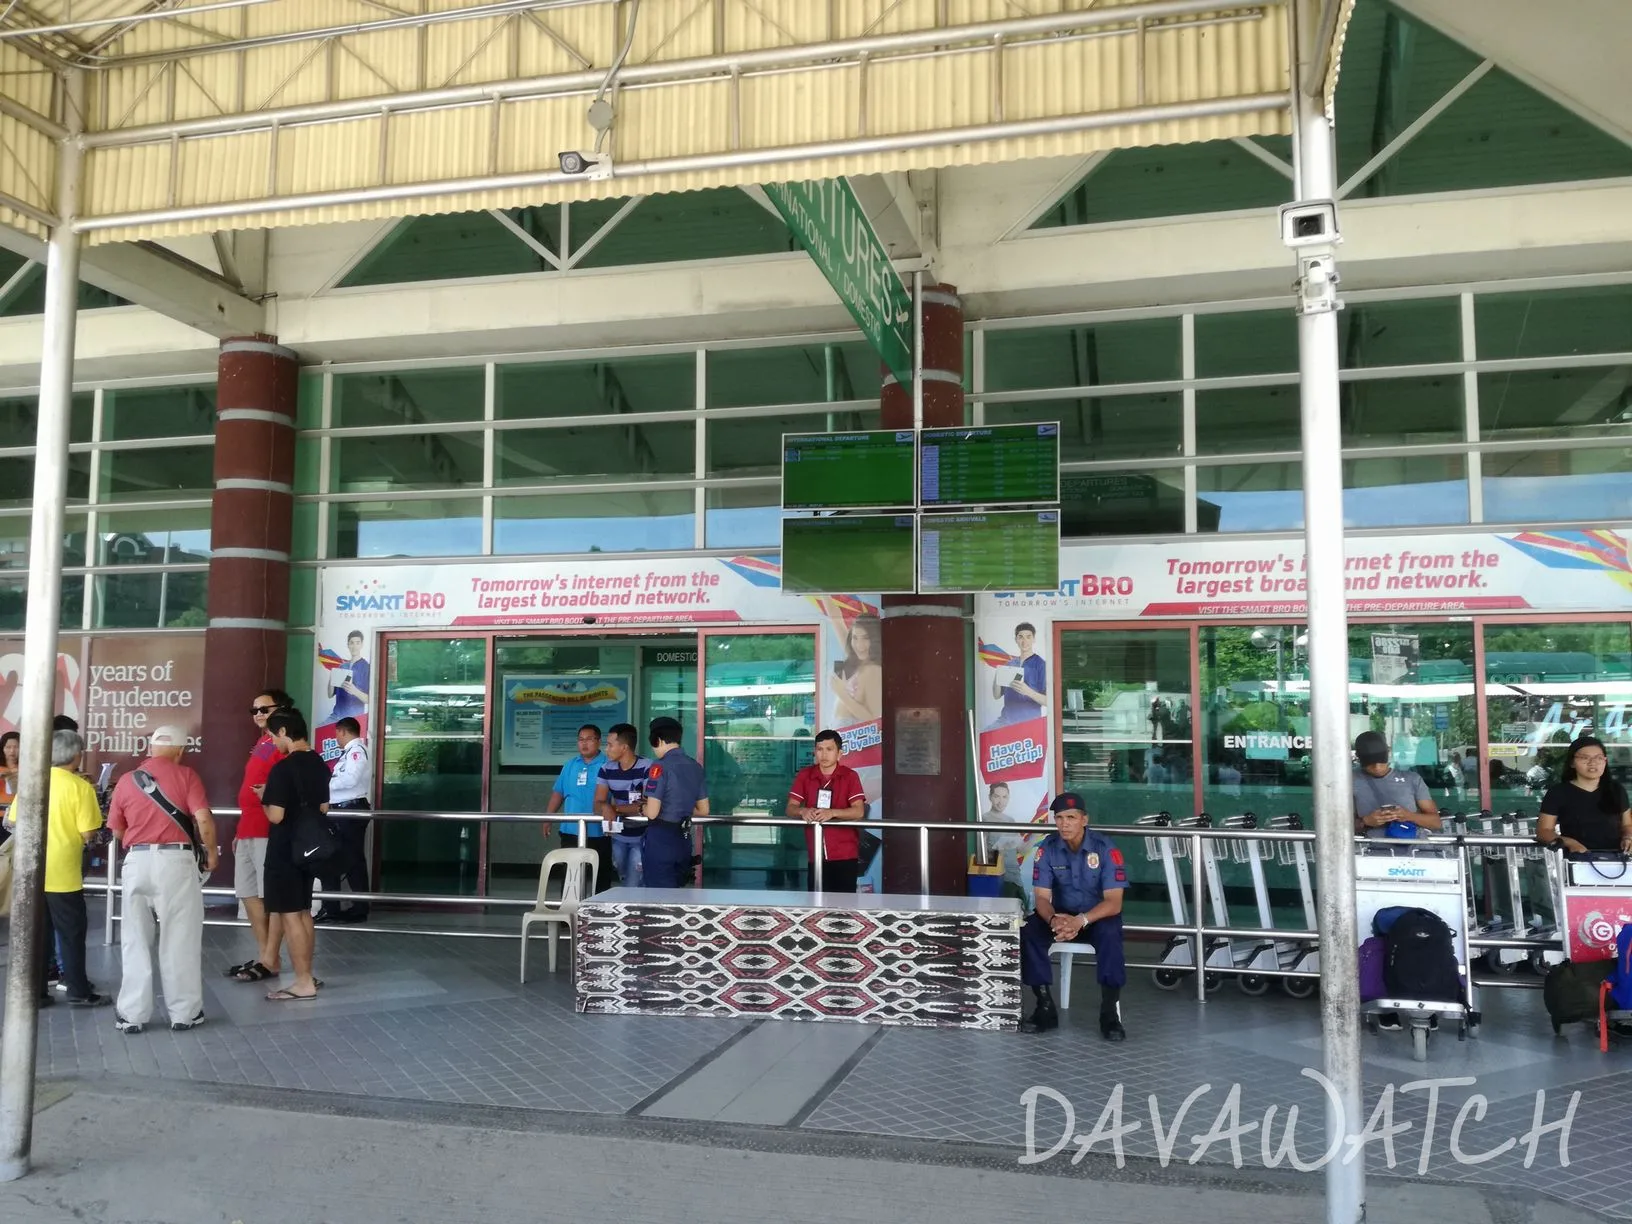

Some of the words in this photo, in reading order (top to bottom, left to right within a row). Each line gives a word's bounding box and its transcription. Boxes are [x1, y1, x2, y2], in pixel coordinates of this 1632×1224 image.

[802, 178, 892, 326] TURES
[843, 271, 881, 343] DOMESTIC
[1167, 554, 1295, 576] Tomorrow's
[1300, 553, 1392, 572] irnet
[1399, 551, 1456, 574] from
[1461, 549, 1499, 569] the
[471, 574, 568, 592] Tomorrow's
[572, 573, 640, 590] internet
[645, 572, 687, 591] from
[691, 571, 720, 587] the
[1176, 576, 1253, 598] largest
[1260, 572, 1380, 593] broaand
[1386, 570, 1488, 590] network.
[478, 593, 538, 612] largest
[541, 590, 632, 608] broadband
[635, 588, 711, 606] network.
[1198, 606, 1220, 615] VISIT
[1222, 606, 1240, 614] THE
[1240, 605, 1271, 614] SMART
[1272, 604, 1291, 613] BRO
[1364, 602, 1440, 611] PRE-DEPARTURE
[617, 615, 674, 623] PRE-DEPARTURE
[657, 652, 698, 662] DOMESTIC
[90, 664, 147, 686] years
[151, 660, 174, 682] of
[88, 686, 192, 707] Prudence
[88, 708, 110, 729] in
[111, 707, 146, 729] the
[841, 725, 877, 740] aayong
[850, 735, 880, 750] byahe
[1224, 735, 1312, 749] ENTRANCE
[86, 731, 202, 756] Philipes
[323, 740, 337, 750] Ha
[991, 742, 1022, 758] Have
[1024, 739, 1032, 749] a
[988, 756, 1013, 771] nice
[1015, 746, 1043, 763] trip!
[1388, 868, 1427, 876] SMART
